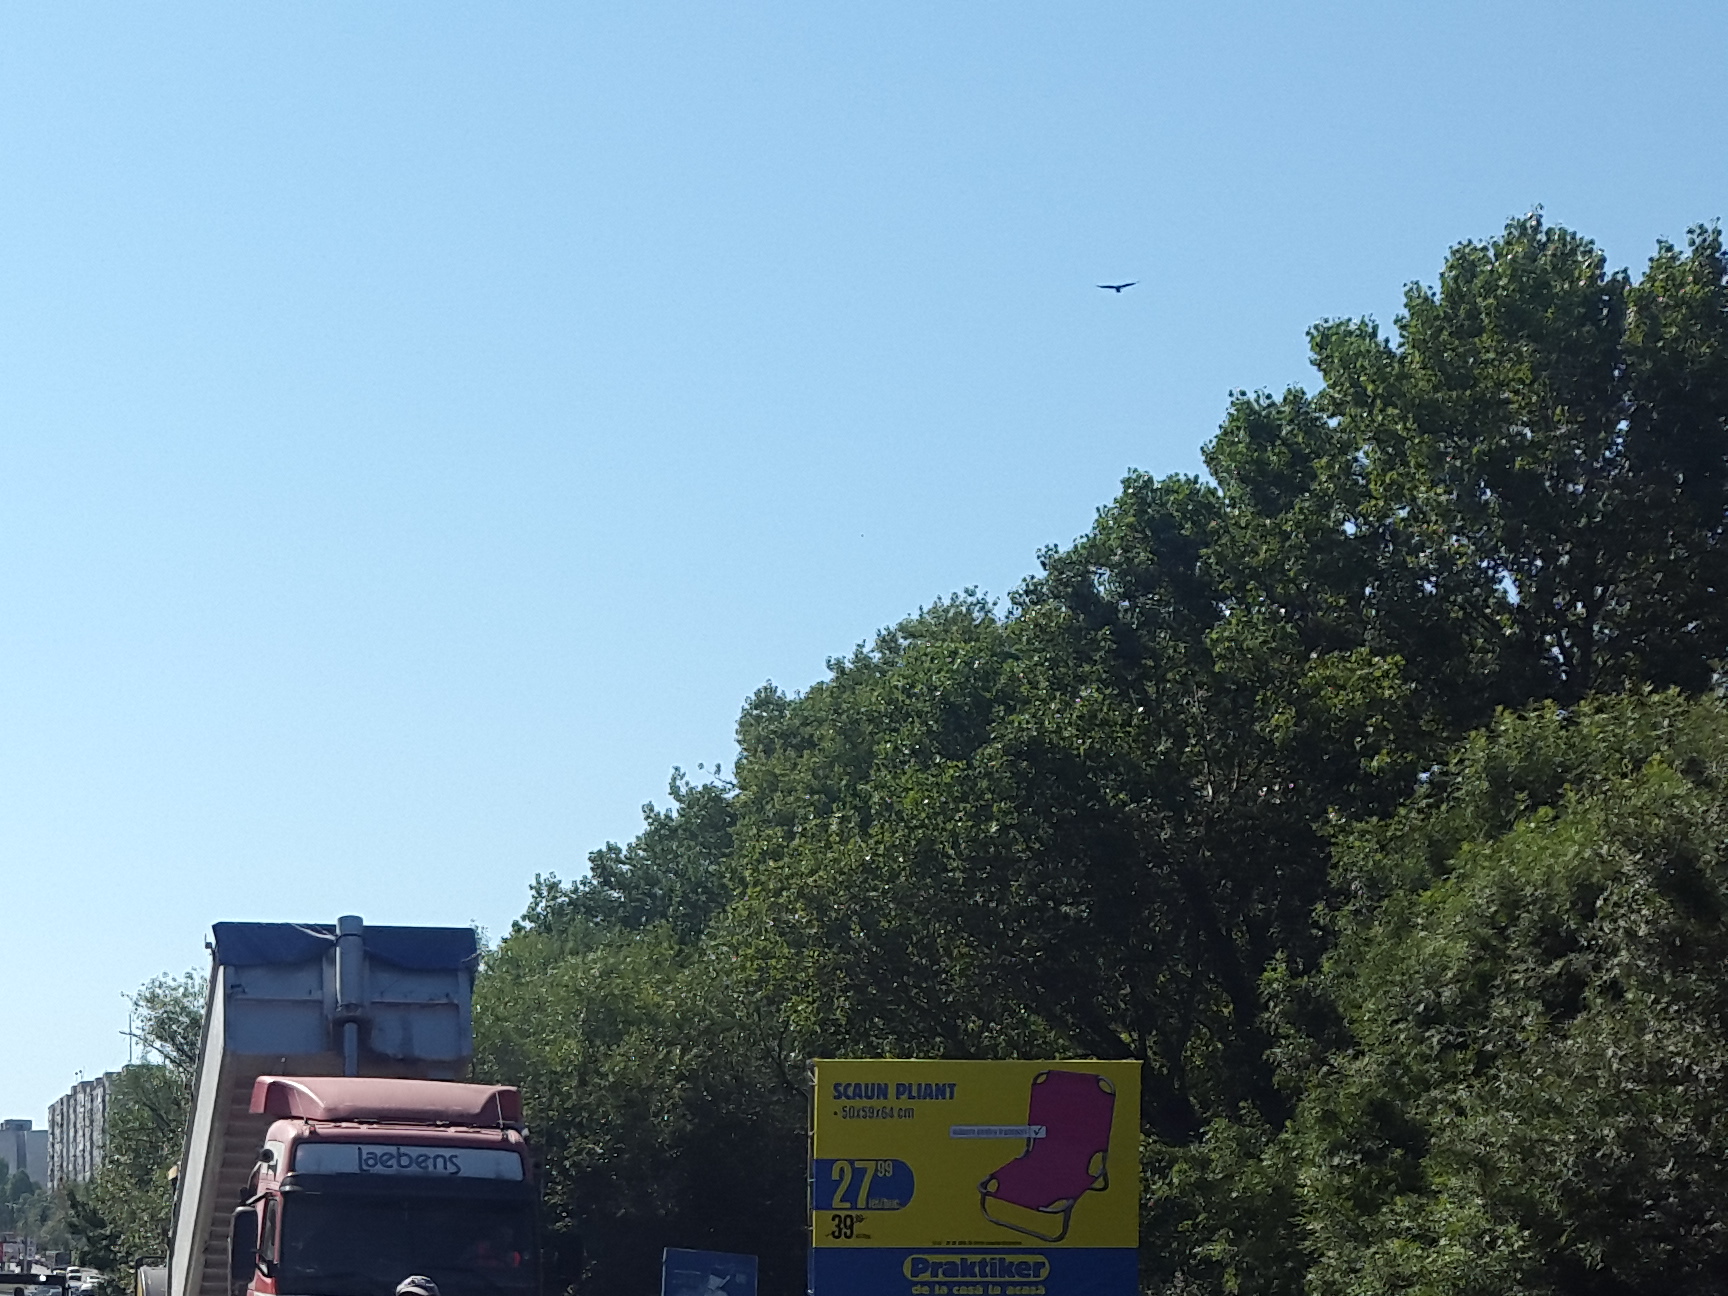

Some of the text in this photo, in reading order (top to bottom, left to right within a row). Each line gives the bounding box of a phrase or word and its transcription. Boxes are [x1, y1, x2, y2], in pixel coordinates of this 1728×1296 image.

[833, 1082, 957, 1100] SCAUN PLIANT
[897, 1107, 914, 1119] cm
[911, 1257, 1046, 1278] Praktiker
